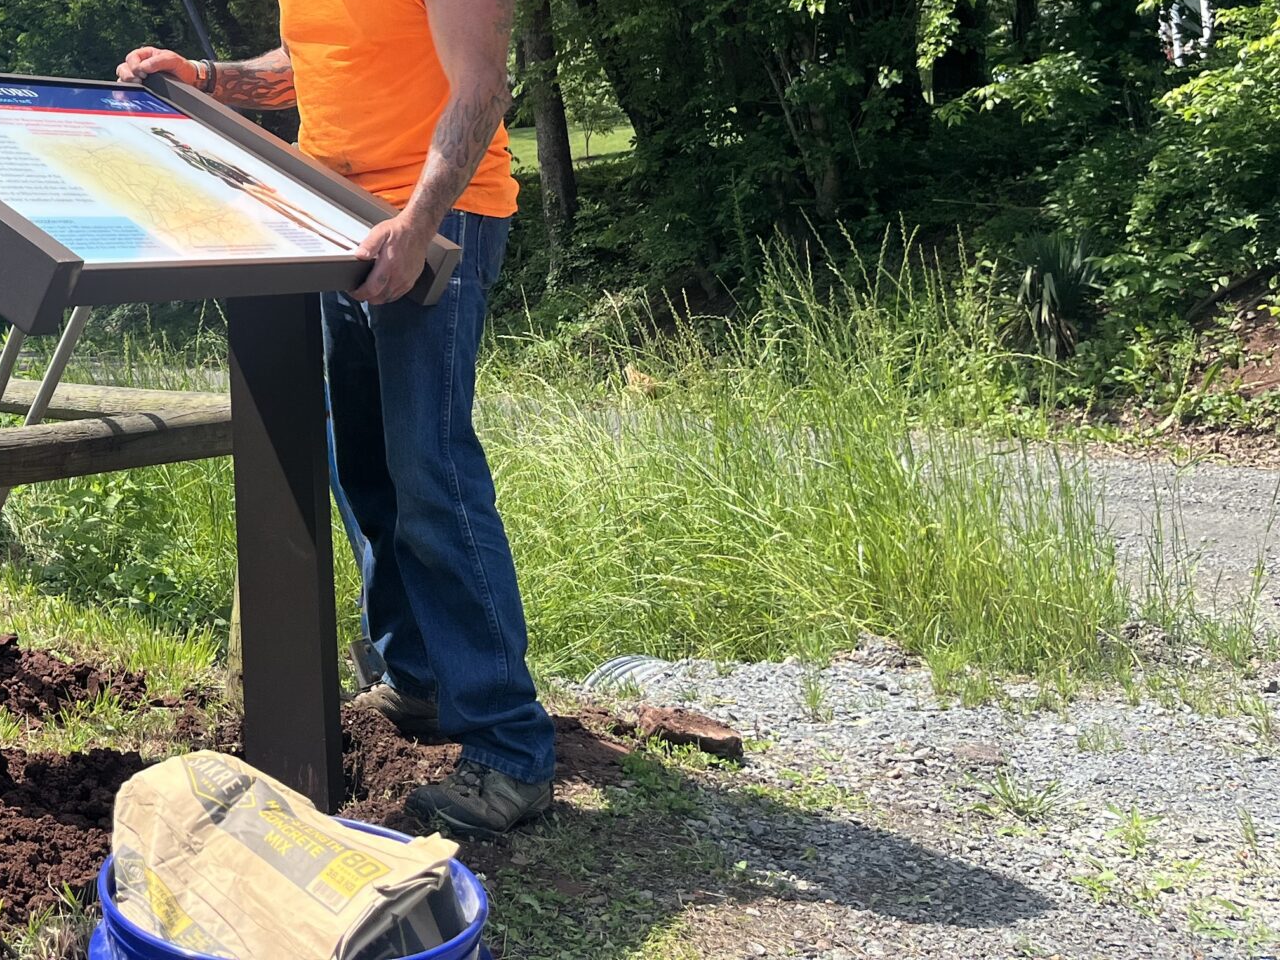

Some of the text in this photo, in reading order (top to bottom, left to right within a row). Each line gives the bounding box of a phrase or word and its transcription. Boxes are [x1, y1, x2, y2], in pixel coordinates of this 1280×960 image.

[188, 756, 244, 795] SAKRE
[259, 810, 326, 858] CONCRETE
[263, 829, 294, 857] MIX
[341, 851, 381, 878] 80
